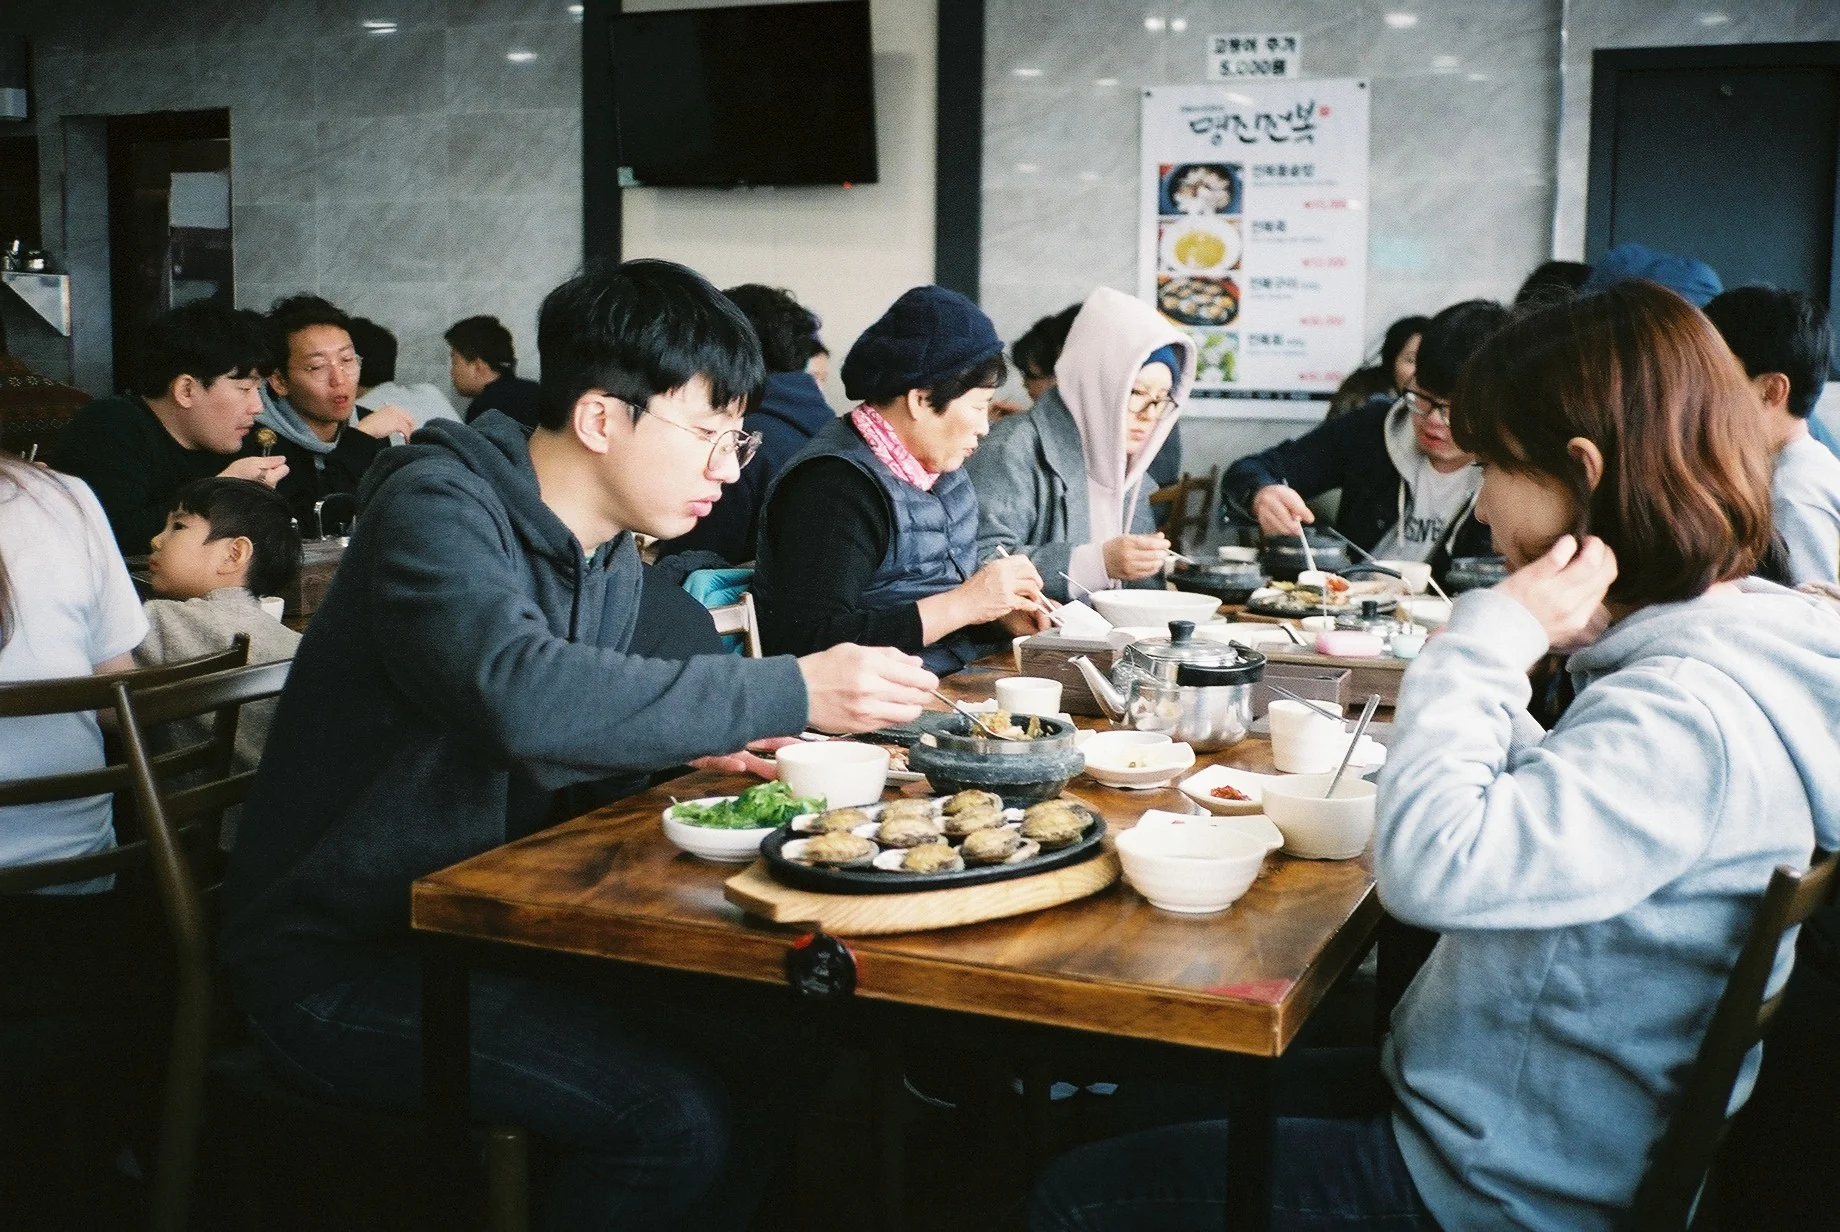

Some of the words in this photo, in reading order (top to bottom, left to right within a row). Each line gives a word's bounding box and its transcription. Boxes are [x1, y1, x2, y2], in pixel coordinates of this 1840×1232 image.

[1214, 38, 1256, 53] 고등어
[1266, 37, 1296, 53] 추가
[1189, 99, 1316, 146] 명진전복
